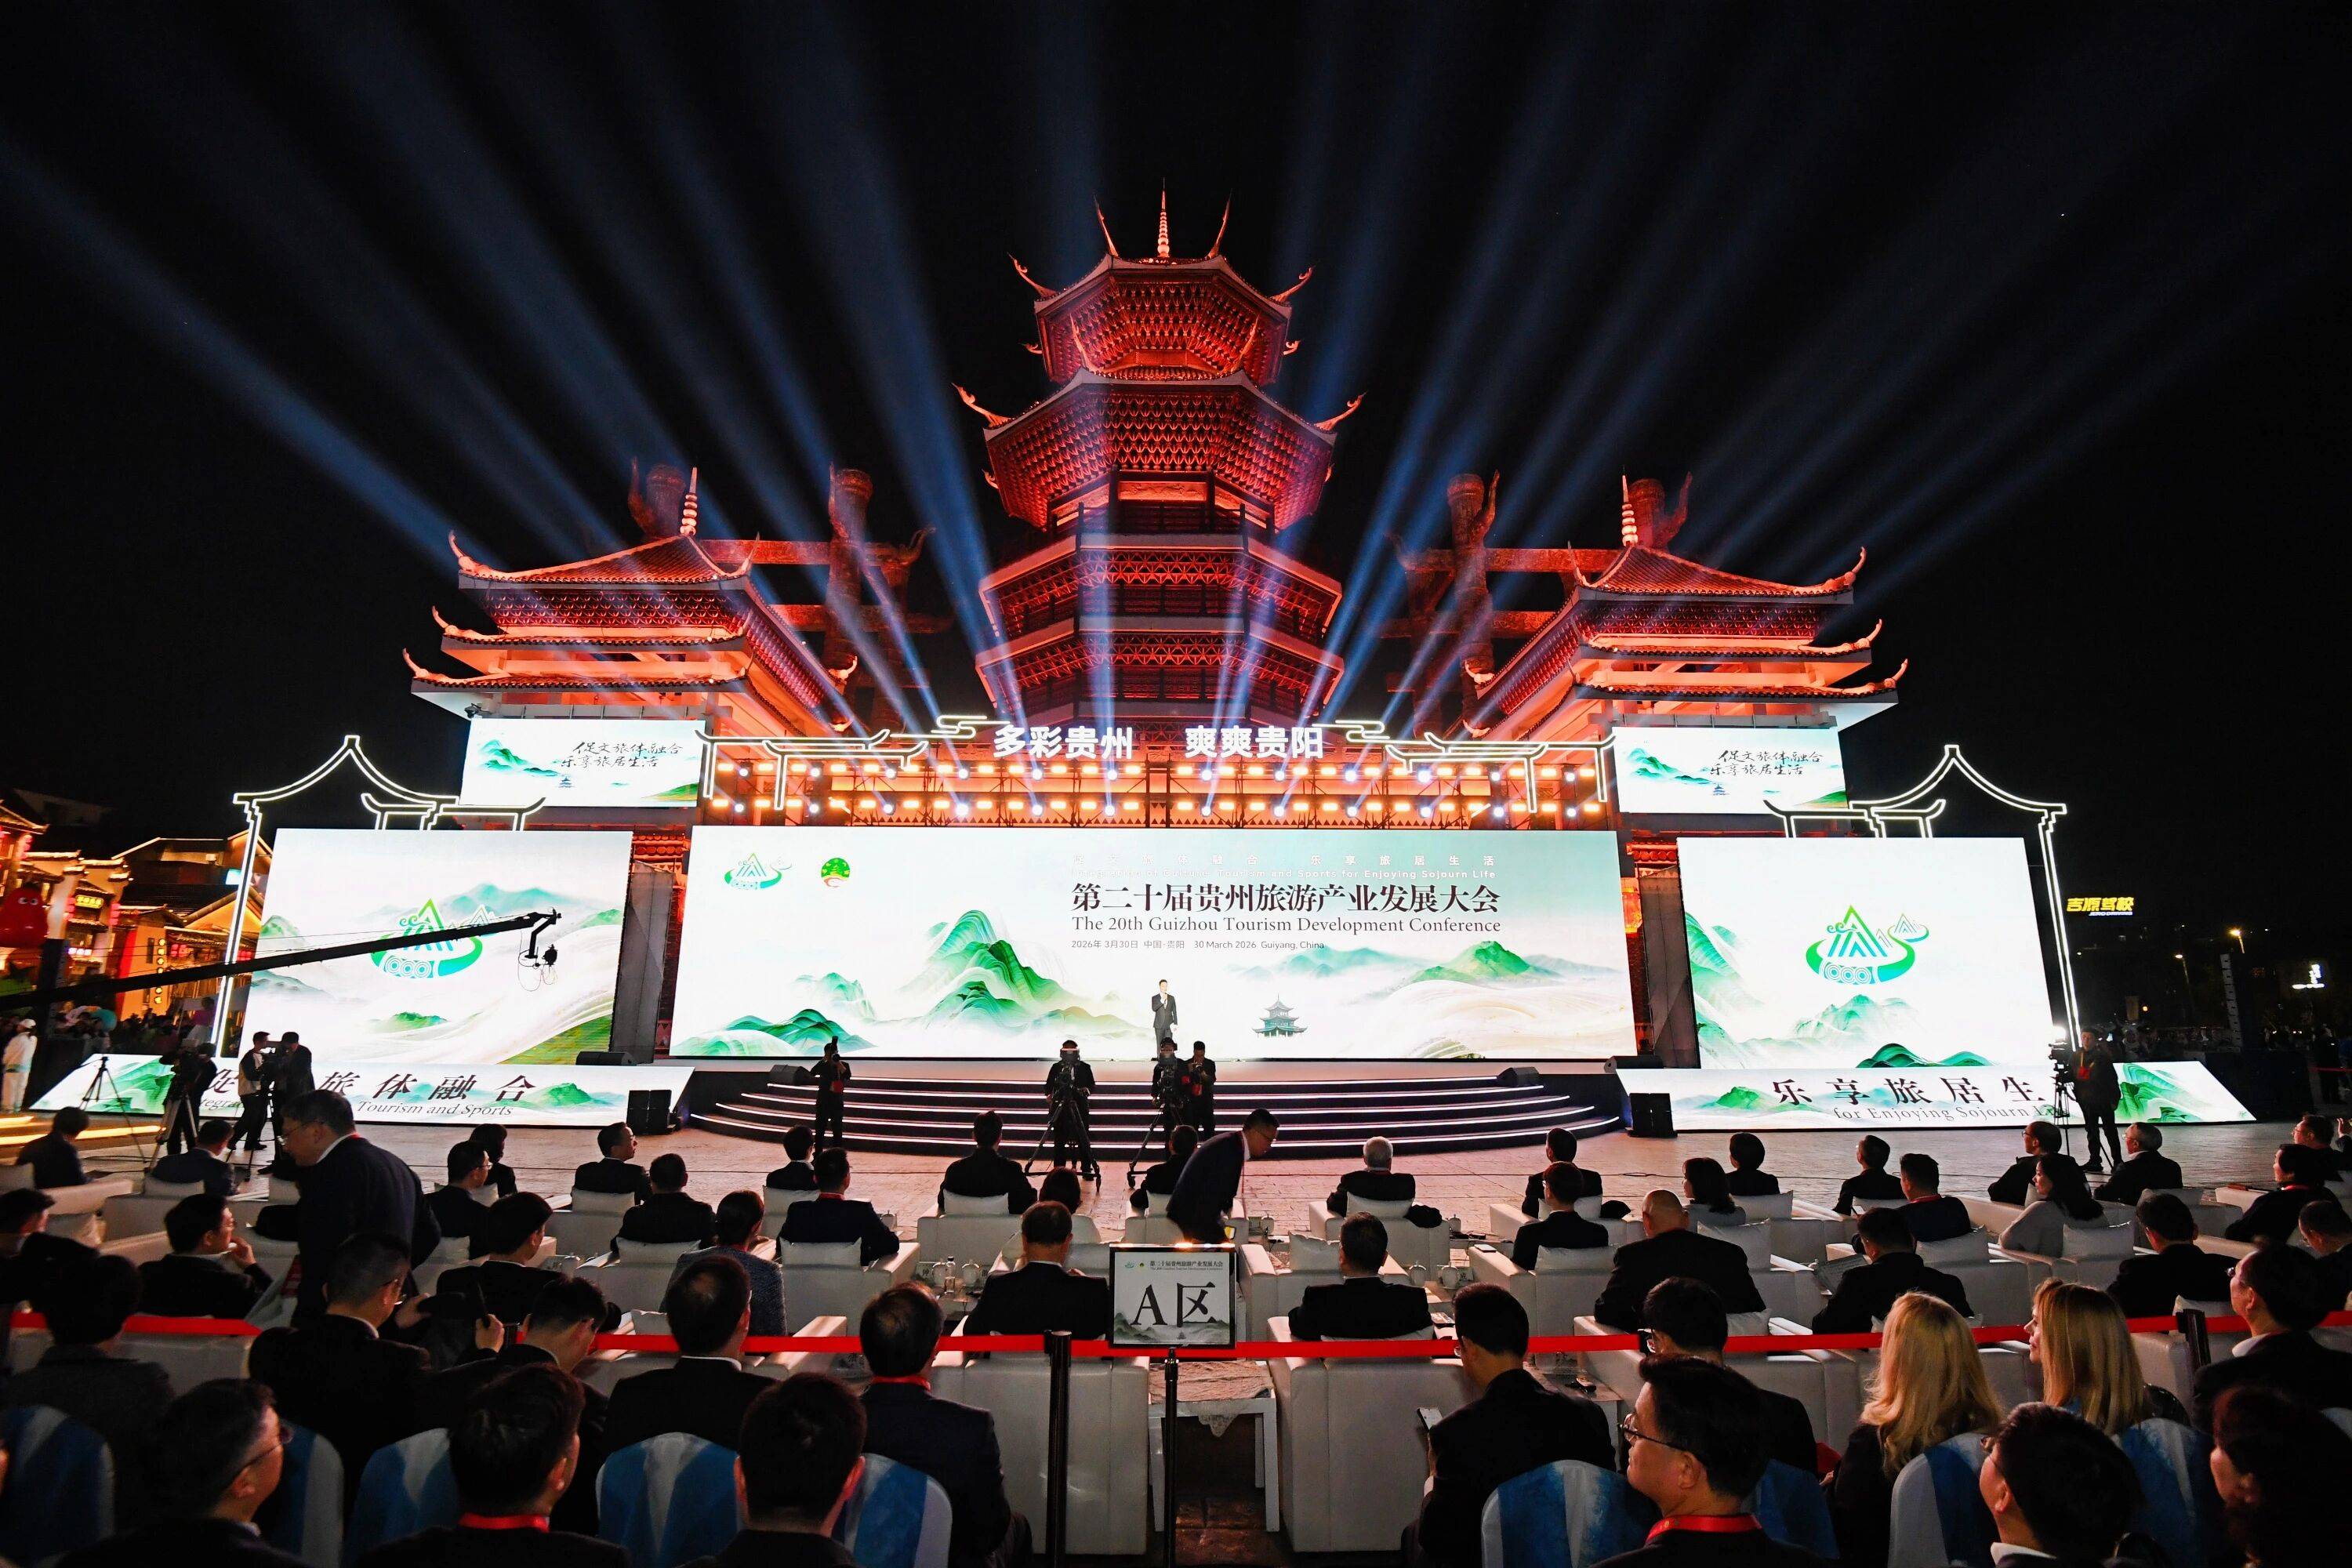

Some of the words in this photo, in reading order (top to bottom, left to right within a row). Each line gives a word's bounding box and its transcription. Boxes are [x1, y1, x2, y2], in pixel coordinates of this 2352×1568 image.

[993, 724, 1132, 759] 多彩贵州
[1185, 725, 1323, 758] 爽爽贵阳
[573, 742, 683, 756] 促文旅体融合
[561, 754, 659, 768] 乐享旅居生活
[1718, 750, 1824, 764] 促文旅体融合
[1710, 764, 1803, 775] 乐享旅居生活
[1218, 869, 1265, 878] Tourism
[1298, 869, 1337, 879] Sports
[1364, 870, 1416, 880] Enjoying
[1422, 870, 1468, 880] Sojourn
[1072, 883, 1501, 913] 第二十届贵州旅游产业发展大会
[1072, 916, 1103, 931] The
[1109, 916, 1142, 931] 20th
[1149, 916, 1218, 931] Guizhou
[1223, 917, 1291, 931] Tourism
[1298, 916, 1403, 935] Development
[1409, 917, 1501, 931] Conference
[1071, 940, 1102, 949] 2026年
[1105, 940, 1138, 949] 3月30日
[1261, 941, 1298, 951] Guiyang,
[357, 1101, 423, 1114] Tourism
[426, 1103, 458, 1115] and
[460, 1104, 514, 1117] Sports
[1833, 1107, 1862, 1119] for
[1867, 1107, 1954, 1121] Enjoying
[1955, 1106, 2030, 1120] Sojourn
